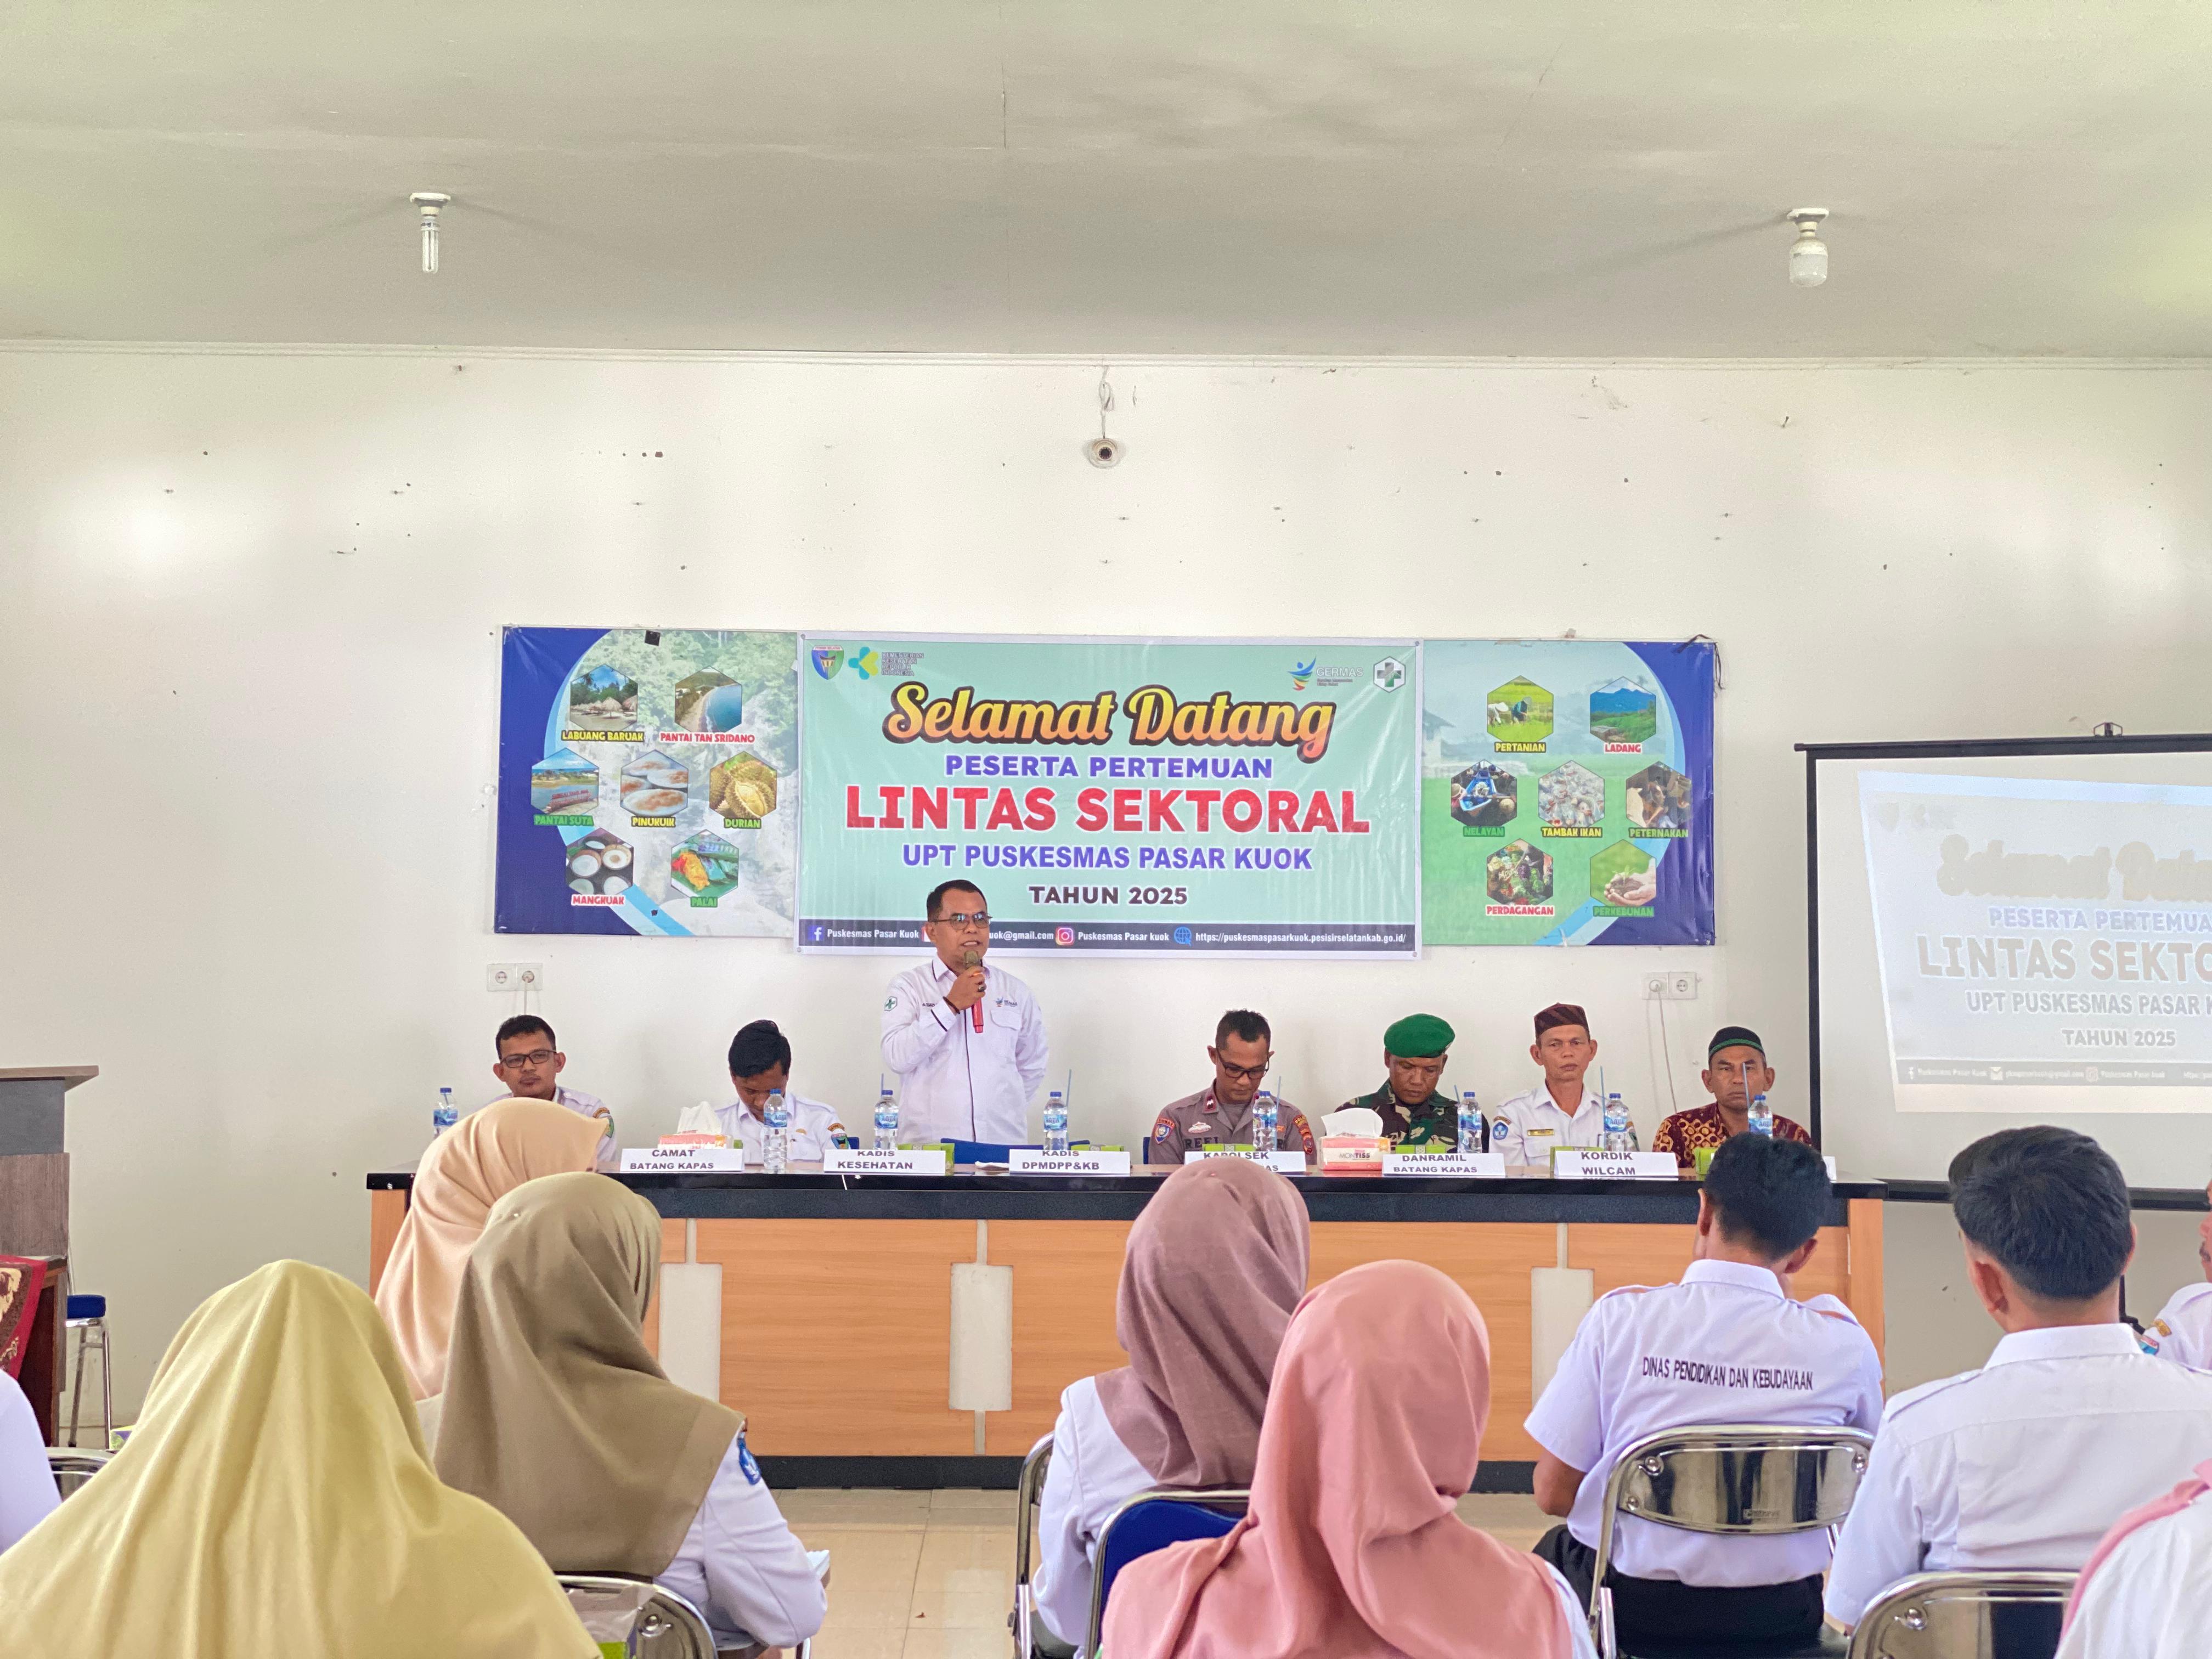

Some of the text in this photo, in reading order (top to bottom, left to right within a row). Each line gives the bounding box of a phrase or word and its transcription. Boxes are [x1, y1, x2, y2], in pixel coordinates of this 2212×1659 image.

[1317, 667, 1364, 677] GERMAS
[882, 681, 1335, 763] Selamat Datang
[562, 730, 645, 742] LABUANG BARUAK
[660, 732, 755, 743] PANTAI TAN SRIDANO
[1495, 743, 1546, 752] PERTANIAN
[1605, 744, 1642, 753] LADANG
[945, 755, 1273, 778] PESERTA PERTEMUAN
[846, 786, 1370, 833] LINTAS SEKTORAL
[534, 815, 594, 826] PANTAI SUTA
[631, 817, 675, 827] PINUKUIK
[724, 818, 761, 828] DURIAN
[1464, 827, 1505, 836] NELAYAN
[1542, 828, 1602, 837] TAMBAK IKAN
[1629, 828, 1688, 838] PETERNAKAN
[903, 845, 1313, 870] UPT PUSKESMAS PASAR KUOK
[572, 895, 624, 905] MANGKUAK
[1029, 885, 1188, 905] TAHUN 2025
[691, 897, 718, 907] PALAI
[1486, 906, 1554, 916] PERDAGANGAN
[1593, 907, 1654, 917] PERKEBUNAN
[1989, 907, 2088, 929] PESERTA
[827, 929, 872, 938] Puskesmas
[874, 929, 898, 938] Pasar
[900, 929, 919, 938] Kuok
[990, 931, 1054, 940] uok@gmail.com
[1078, 932, 1169, 941] Puskesmas Pasar kuok
[1195, 933, 1406, 944] https://puskesmaspasarkuok.pesisirselatankab.go.id/
[1917, 936, 2076, 980] LINTAS
[1966, 991, 2006, 1012] UPT
[2012, 992, 2132, 1014] PUSKESMAS
[2138, 995, 2200, 1015] PASAR
[2061, 1029, 2176, 1047] TAHUN 2025
[1581, 1152, 1633, 1160] KORDIK
[1582, 1167, 1635, 1175] WILCAM
[1643, 1357, 1813, 1391] DINAS PENDIDIKAN DAN KEBUDAYAAN
